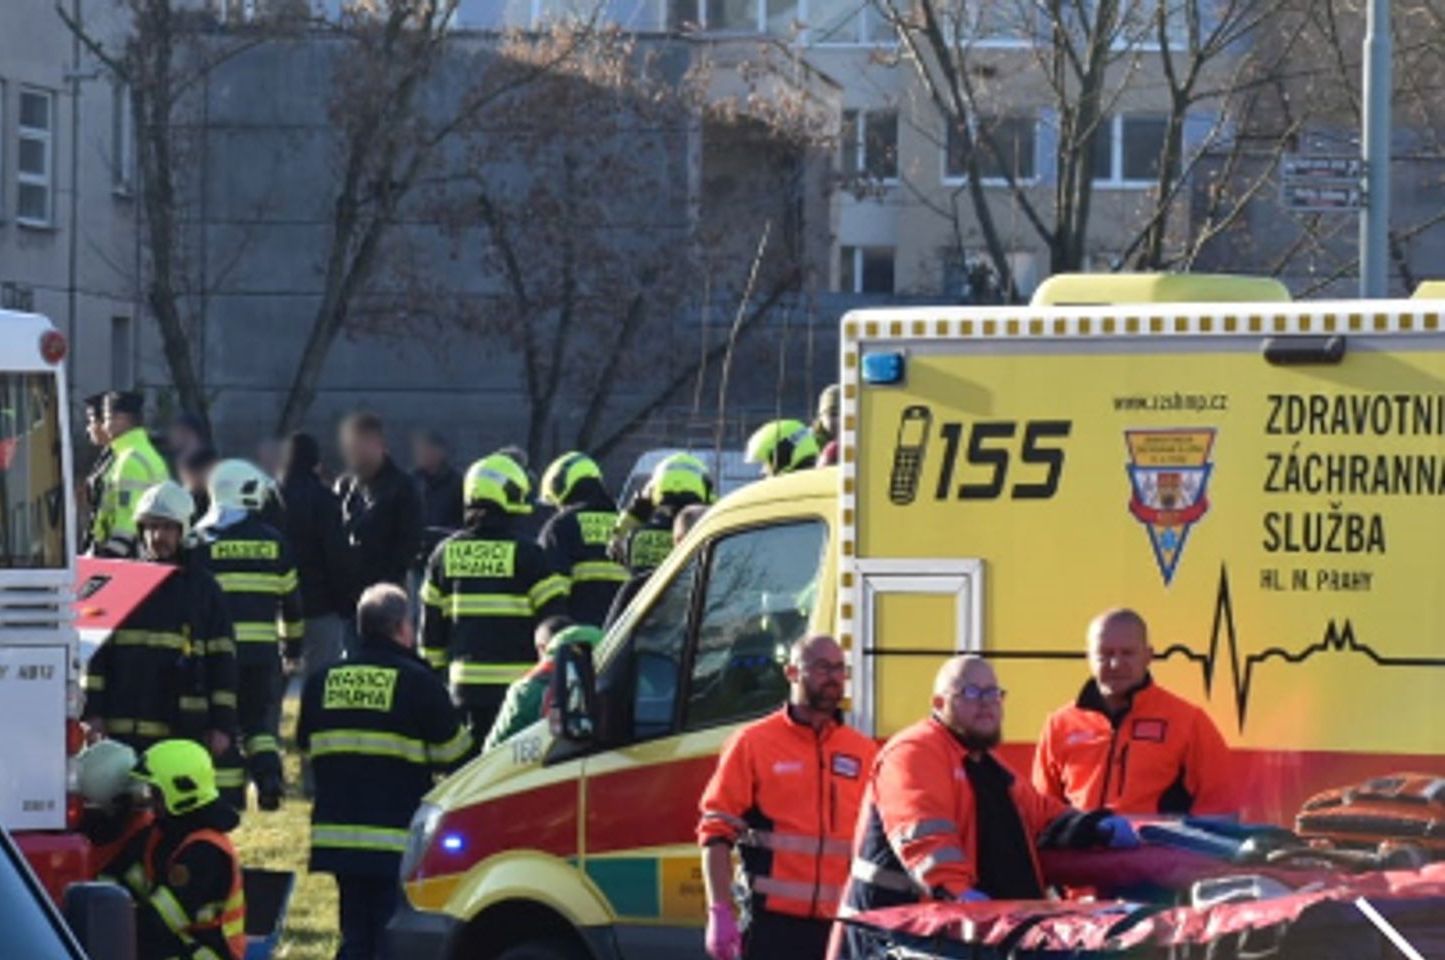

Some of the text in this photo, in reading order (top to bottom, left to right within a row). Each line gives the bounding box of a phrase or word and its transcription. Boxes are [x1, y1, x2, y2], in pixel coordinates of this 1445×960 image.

[935, 420, 1073, 500] 155
[1263, 501, 1386, 555] SLUŽBA
[1317, 568, 1373, 592] PRAHY
